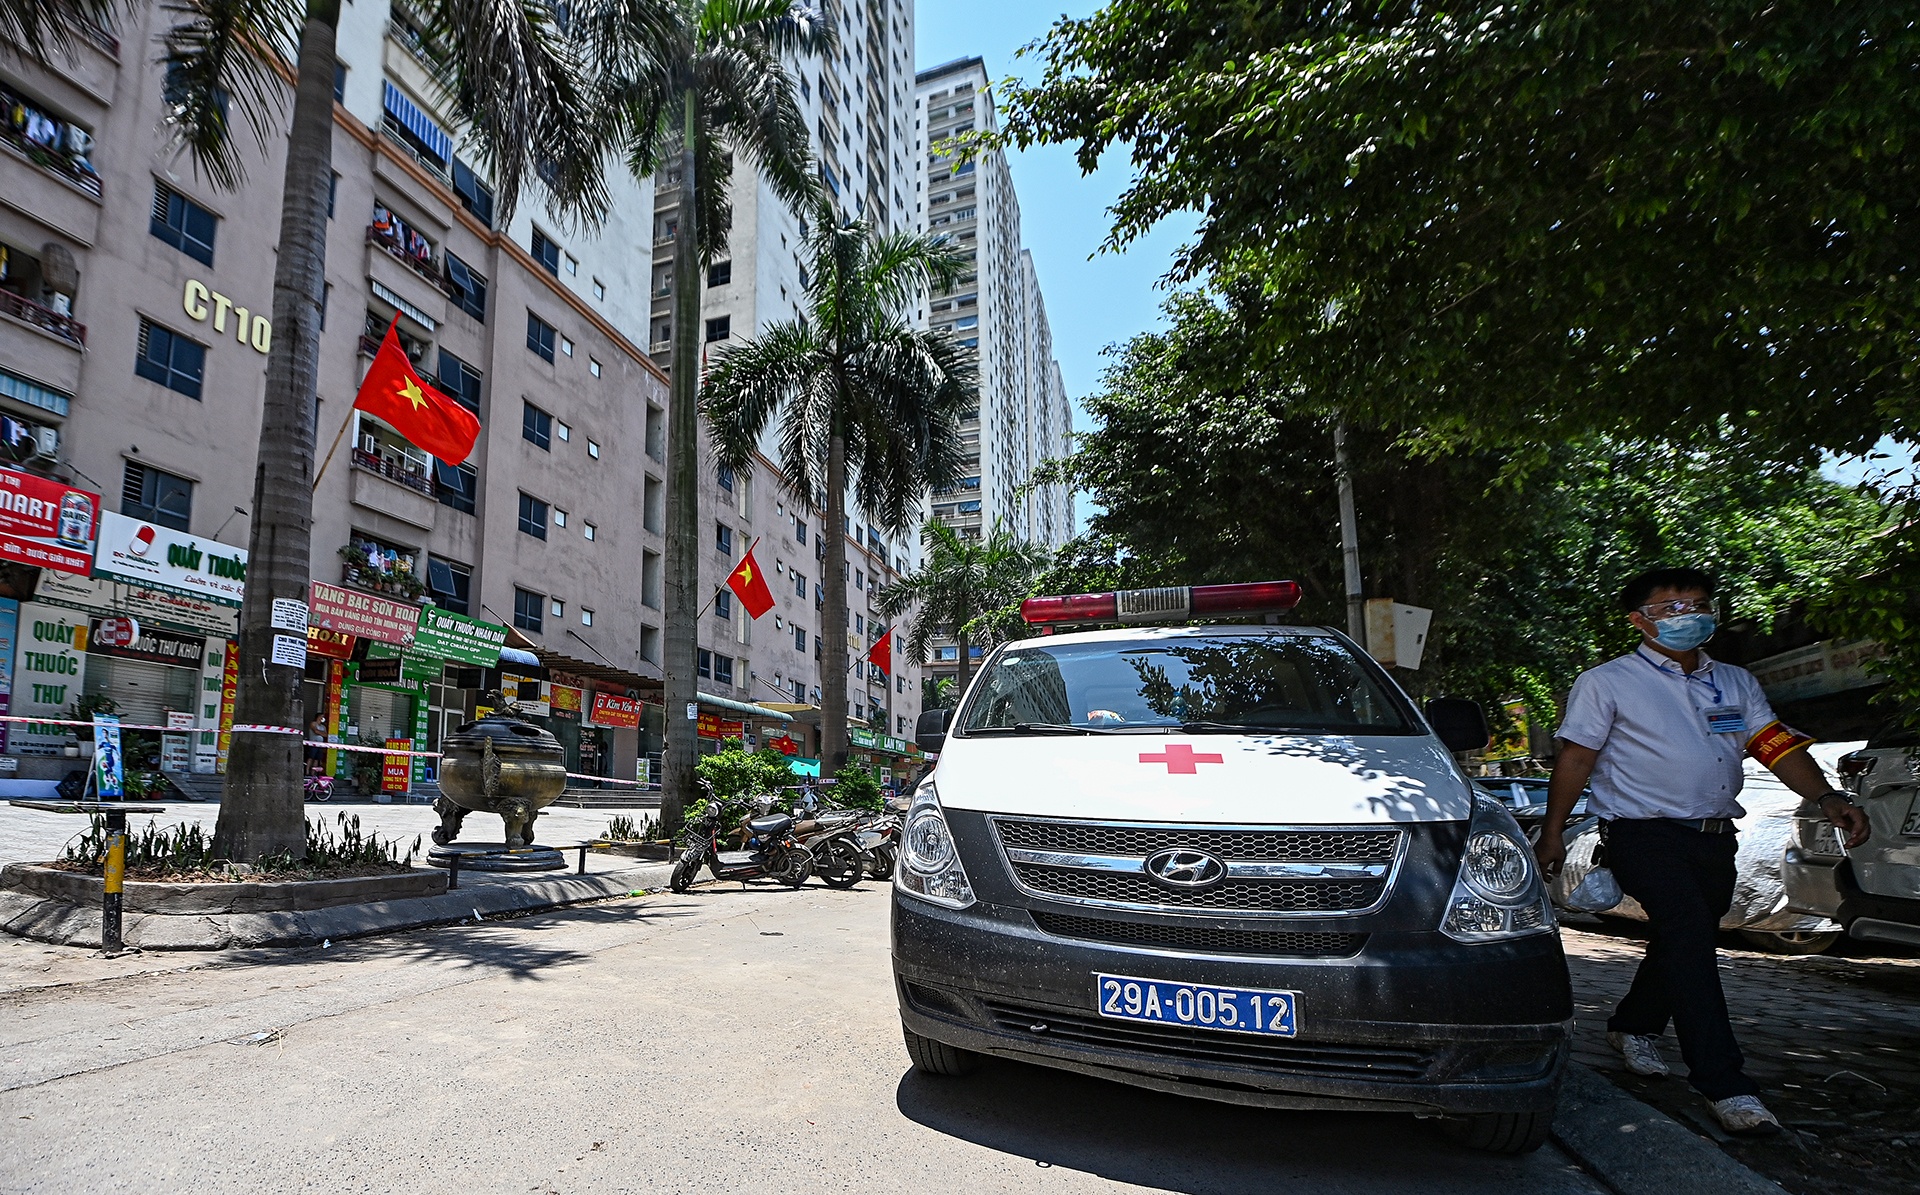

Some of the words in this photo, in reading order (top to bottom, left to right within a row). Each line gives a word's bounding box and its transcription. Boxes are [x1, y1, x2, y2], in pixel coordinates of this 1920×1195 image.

[184, 279, 272, 354] CT10
[315, 585, 345, 605] VÀNG
[347, 593, 370, 612] BẠC
[315, 603, 330, 613] MUA
[33, 617, 75, 644] QUẦY
[24, 649, 78, 676] THUỐC
[32, 683, 68, 705] THƯ
[606, 699, 620, 710] Kim
[621, 700, 632, 712] Yến
[387, 768, 404, 776] MUA
[1104, 980, 1290, 1032] 29A-005.12
